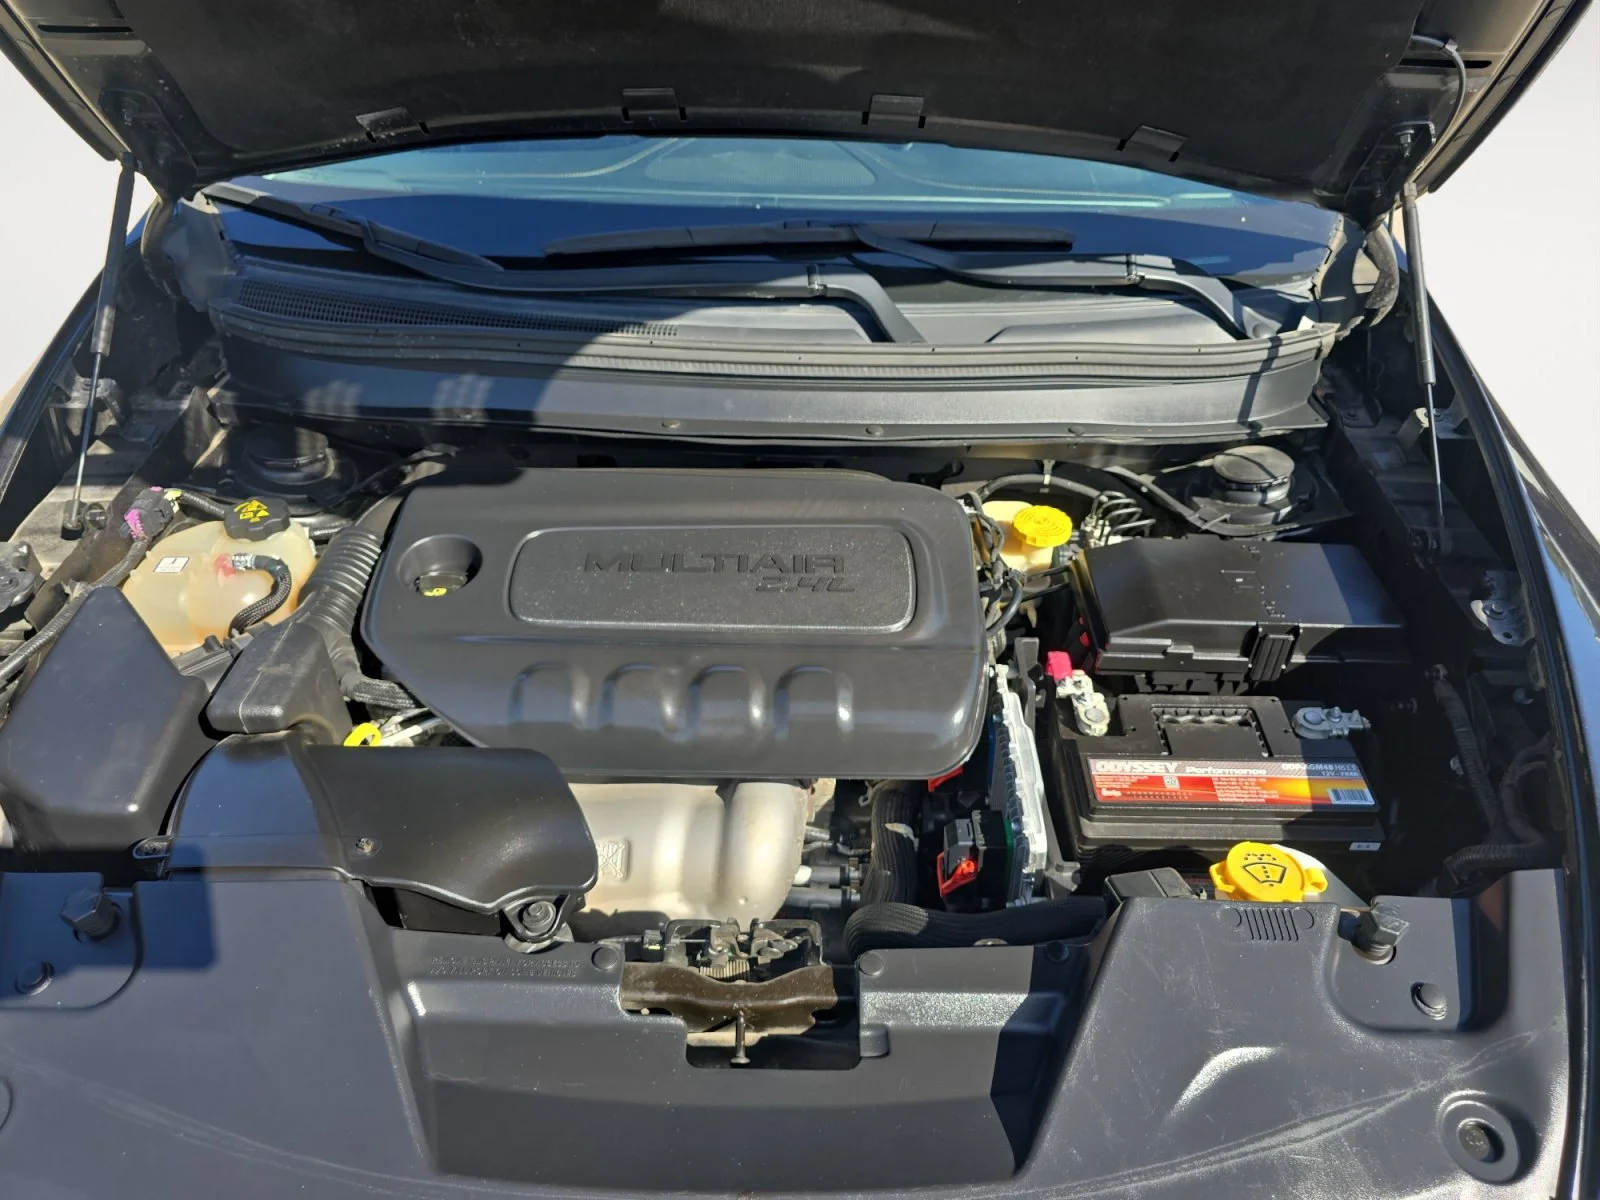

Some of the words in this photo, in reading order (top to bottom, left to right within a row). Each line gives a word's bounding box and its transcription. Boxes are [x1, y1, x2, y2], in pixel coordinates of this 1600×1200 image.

[584, 552, 845, 574] MULTIAIR
[1095, 761, 1178, 773] ODYSSEY
[1185, 765, 1267, 775] Performance
